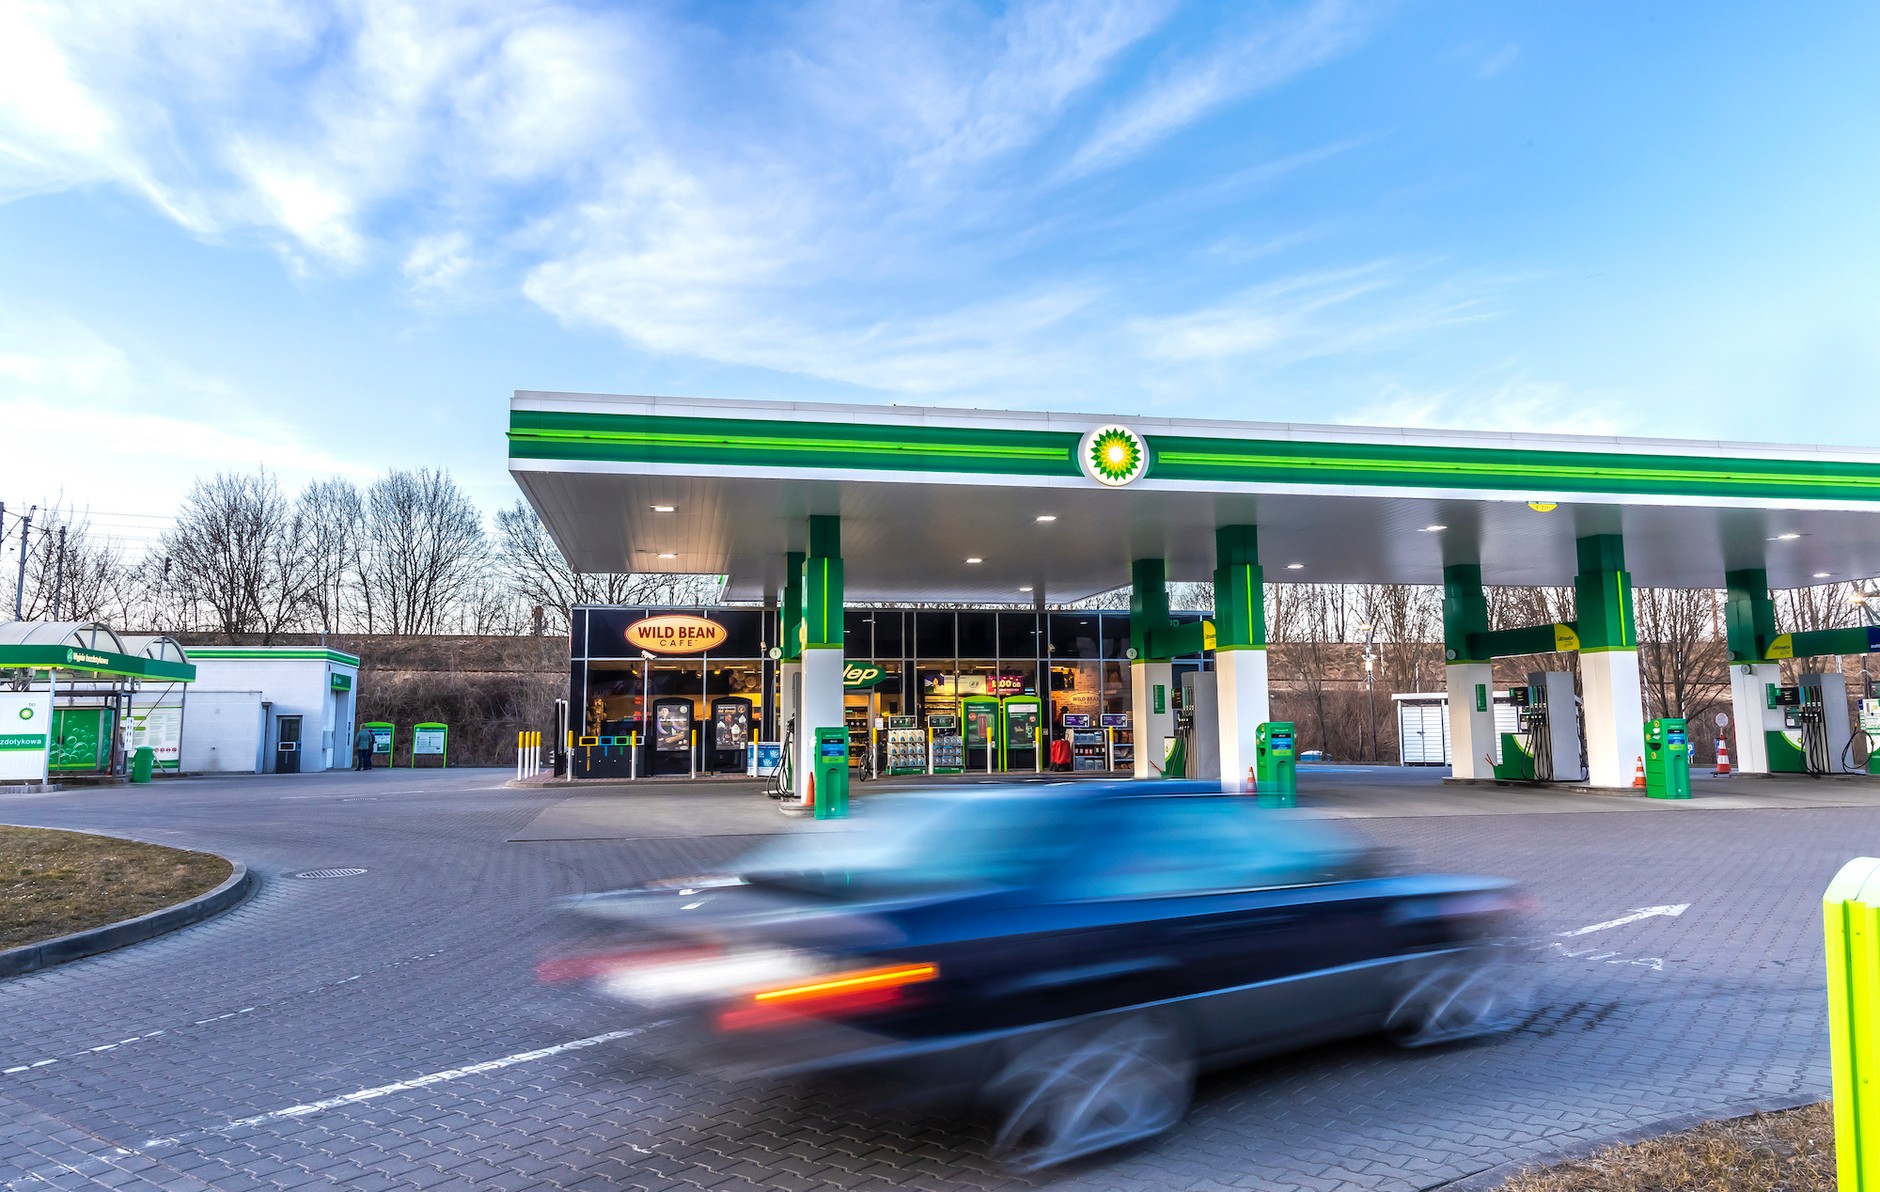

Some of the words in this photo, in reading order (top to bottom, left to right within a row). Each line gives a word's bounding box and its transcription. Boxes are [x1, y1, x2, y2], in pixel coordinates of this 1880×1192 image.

[638, 626, 675, 638] WILD
[679, 626, 715, 638] BEAN
[659, 639, 693, 647] CAFE
[843, 664, 880, 685] lep
[0, 738, 42, 746] zdotykowa
